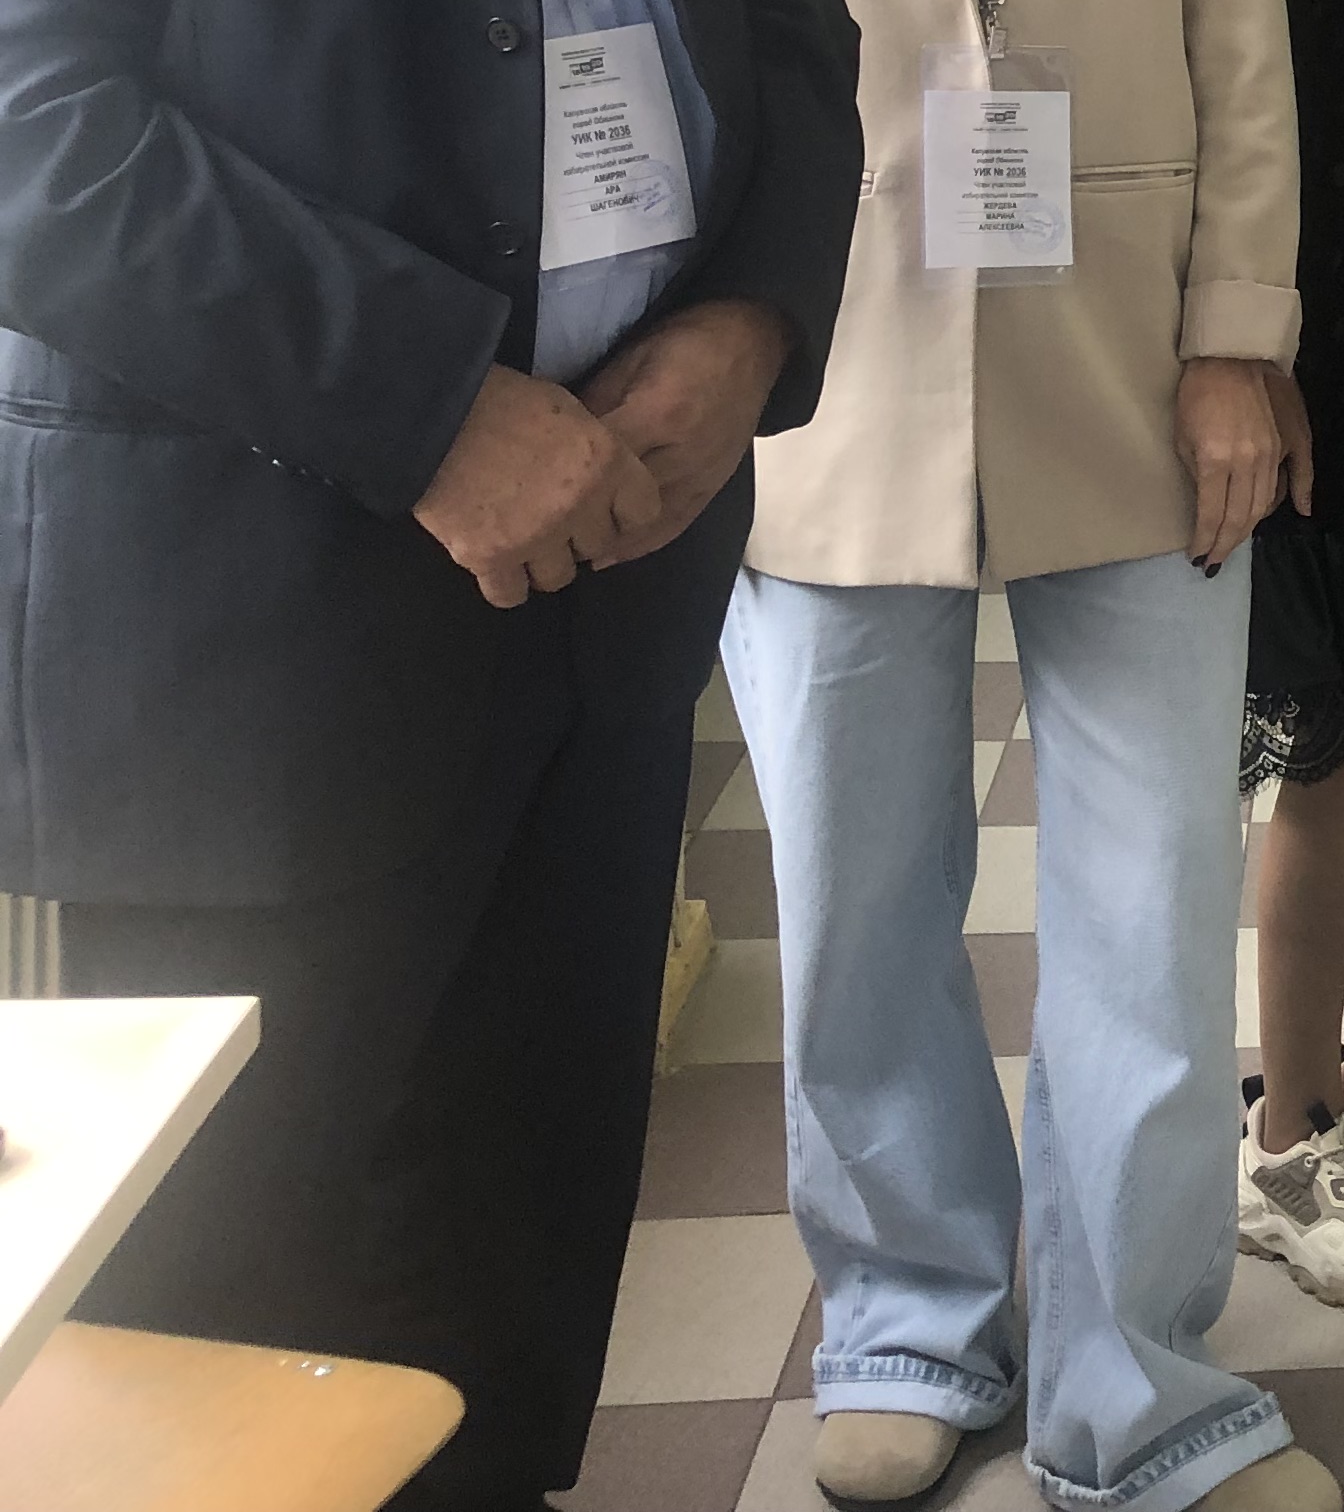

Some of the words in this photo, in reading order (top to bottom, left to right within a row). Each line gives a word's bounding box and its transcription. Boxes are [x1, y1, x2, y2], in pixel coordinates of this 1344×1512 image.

[571, 132, 593, 145] УИК
[594, 129, 606, 141] №
[973, 168, 992, 177] УИК
[605, 184, 621, 195] АРА
